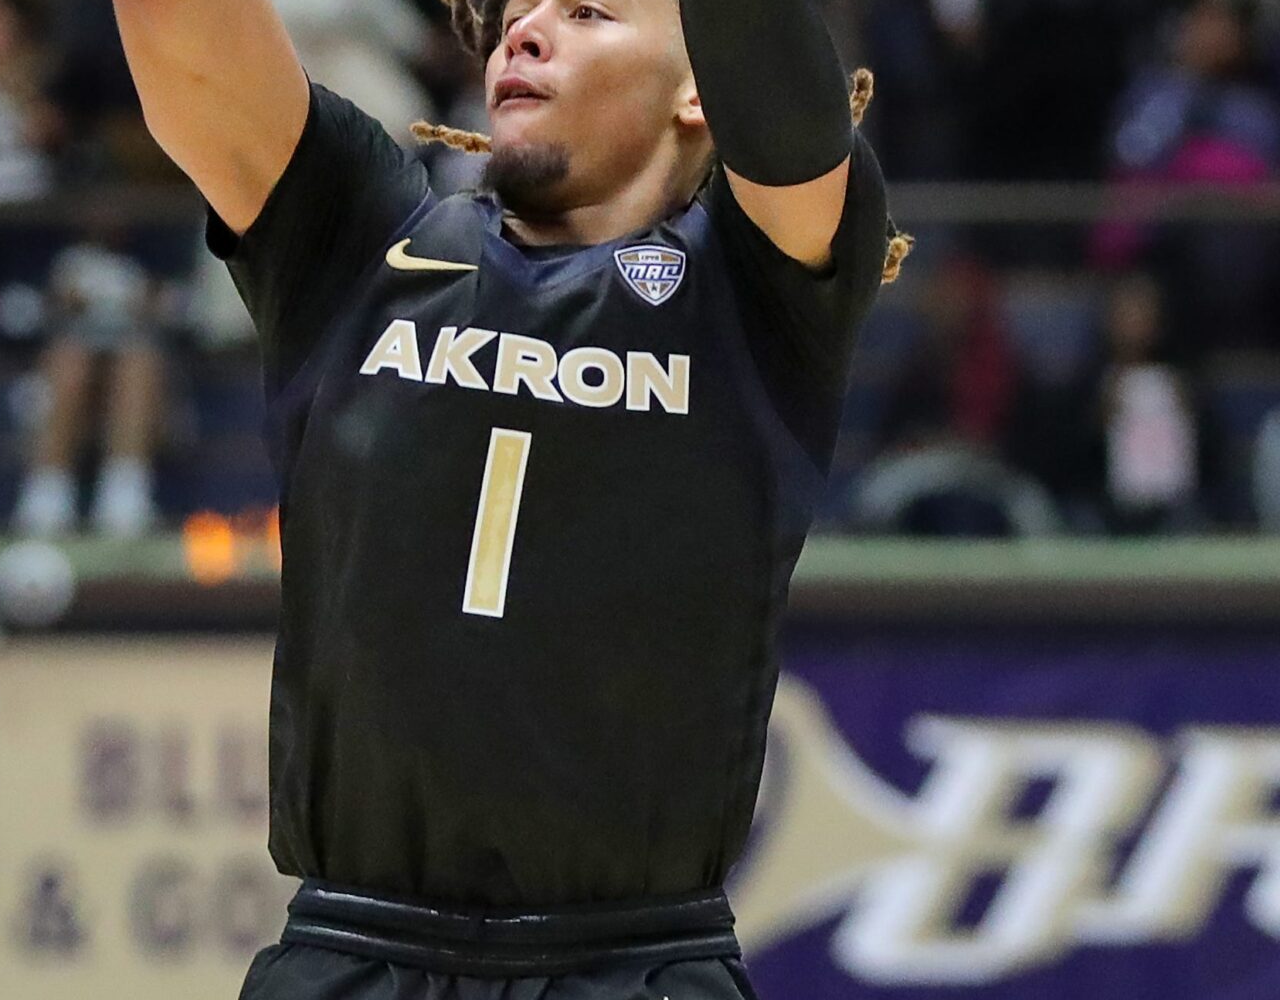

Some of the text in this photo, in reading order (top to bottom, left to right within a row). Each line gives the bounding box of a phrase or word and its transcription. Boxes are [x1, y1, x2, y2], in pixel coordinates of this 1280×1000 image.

[624, 264, 681, 280] MAC
[359, 319, 691, 415] AKRON
[462, 427, 532, 619] 1
